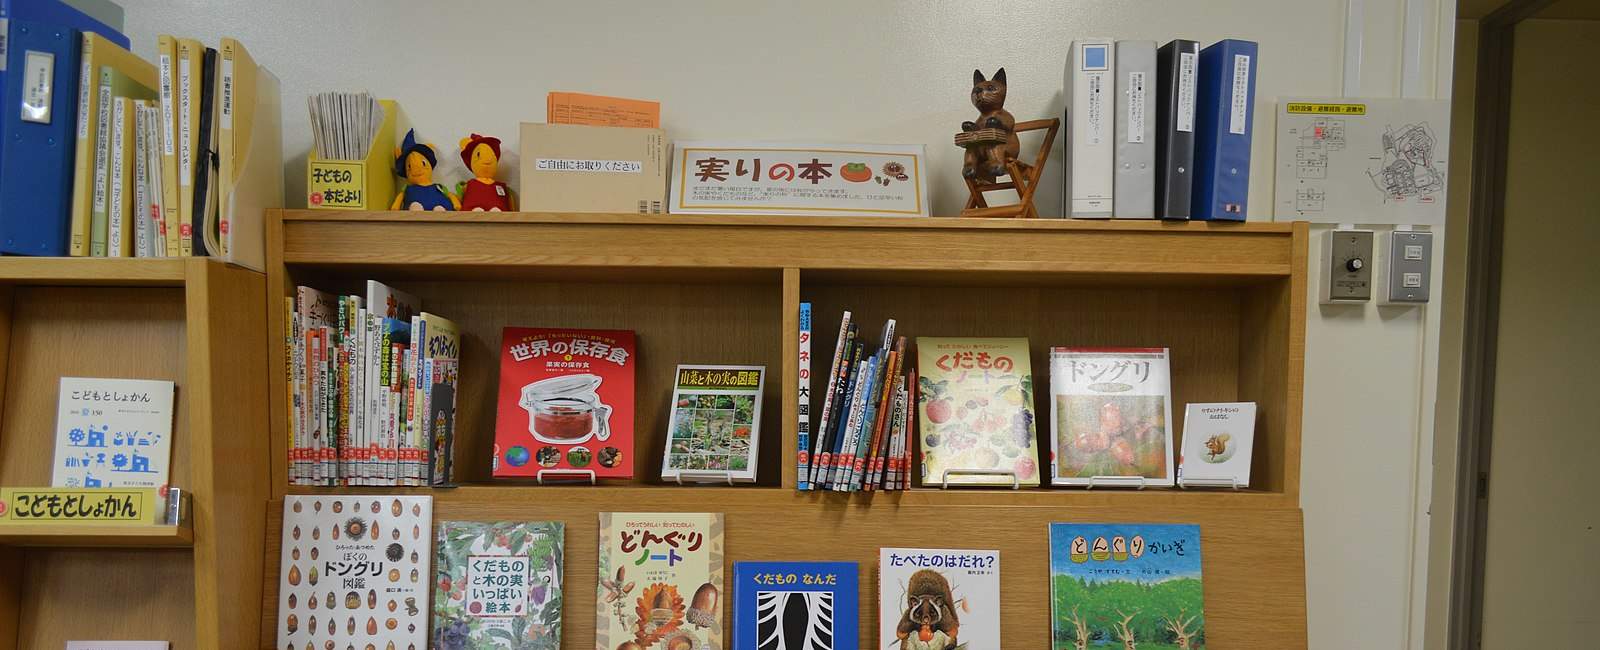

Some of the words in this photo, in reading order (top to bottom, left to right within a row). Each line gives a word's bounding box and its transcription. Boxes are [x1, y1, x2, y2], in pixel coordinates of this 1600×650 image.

[538, 159, 641, 172] ご自由にお取りください
[695, 157, 833, 184] 実りの本
[313, 168, 352, 183] 子どもの
[324, 189, 361, 203] 本だより
[429, 335, 458, 359] まつぼっくり
[509, 339, 630, 366] 世界の保存食
[936, 352, 1013, 373] くだもの
[681, 371, 759, 386] 山菜と木の実の図鑑
[1069, 361, 1152, 383] ドングリ
[799, 332, 809, 433] タネの大図鑑
[71, 391, 152, 402] こどもとしょかん
[844, 380, 854, 407] ドングリ
[15, 494, 137, 518] こどもとしょかん
[620, 530, 703, 553] どんぐり
[1074, 537, 1142, 554] どんぐり
[1148, 539, 1186, 557] かいぎ
[343, 552, 368, 561] ぼくの
[635, 549, 683, 566] ノート
[889, 553, 995, 569] たべたのはだれ？
[324, 560, 383, 576] ドングリ
[472, 560, 524, 573] くだもの
[343, 577, 366, 589] 図鑑
[472, 574, 523, 587] と木の実
[753, 573, 797, 585] くだもの
[802, 574, 837, 585] なんだ
[473, 588, 522, 600] いっぱい
[485, 601, 511, 614] 絵本
